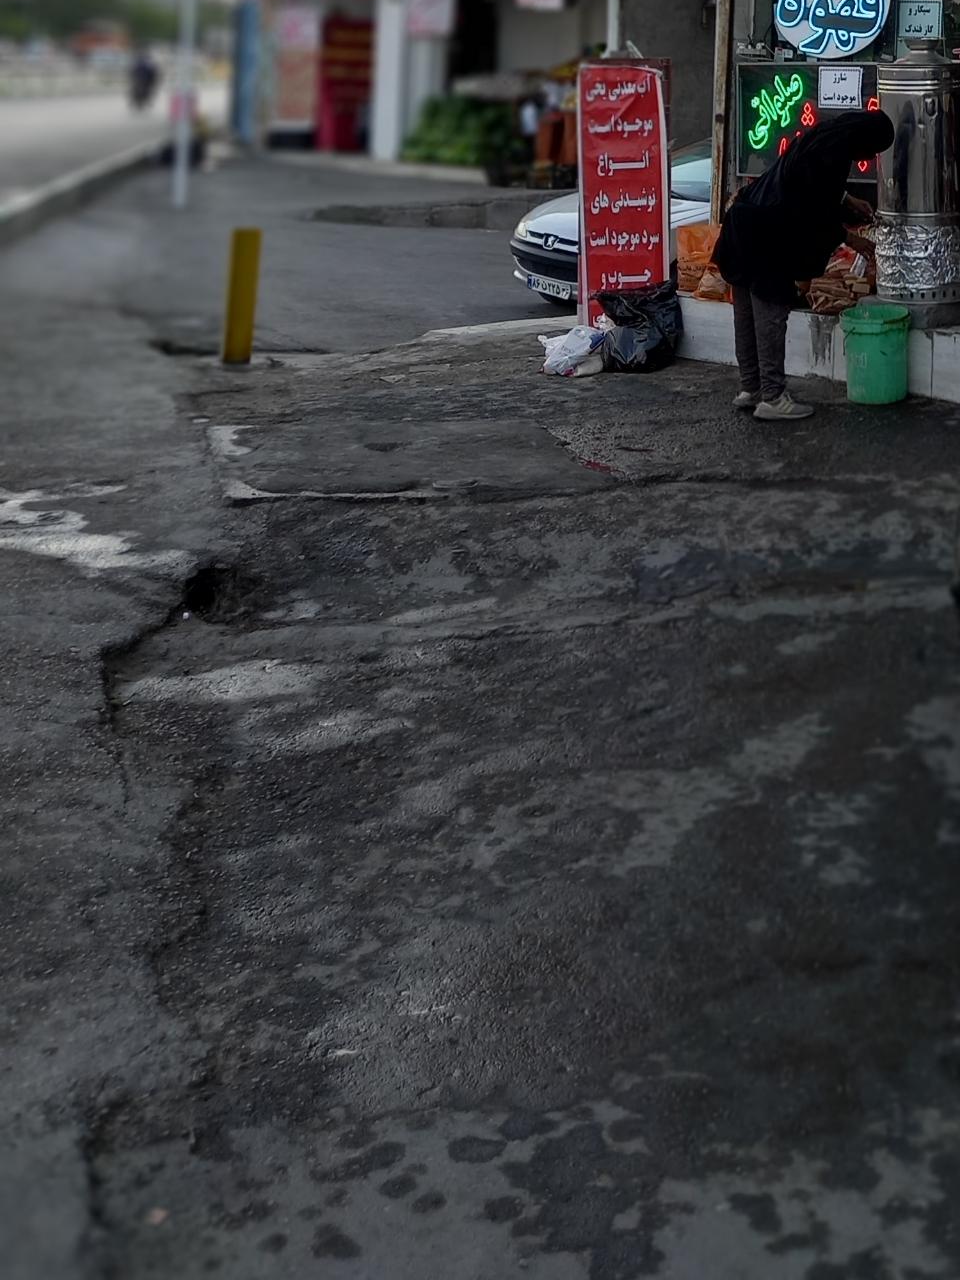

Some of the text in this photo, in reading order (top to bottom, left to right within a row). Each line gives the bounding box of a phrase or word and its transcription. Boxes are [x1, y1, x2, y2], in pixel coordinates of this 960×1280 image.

[913, 4, 931, 16] سیگار
[609, 78, 636, 100] معدنی
[637, 72, 651, 97] آب
[823, 92, 856, 104] موجود است
[588, 113, 653, 137] موجود است
[597, 150, 649, 176] انواع
[590, 187, 656, 214] نوشیدنی های
[590, 227, 660, 251] سرد موجود است
[601, 272, 606, 289] و
